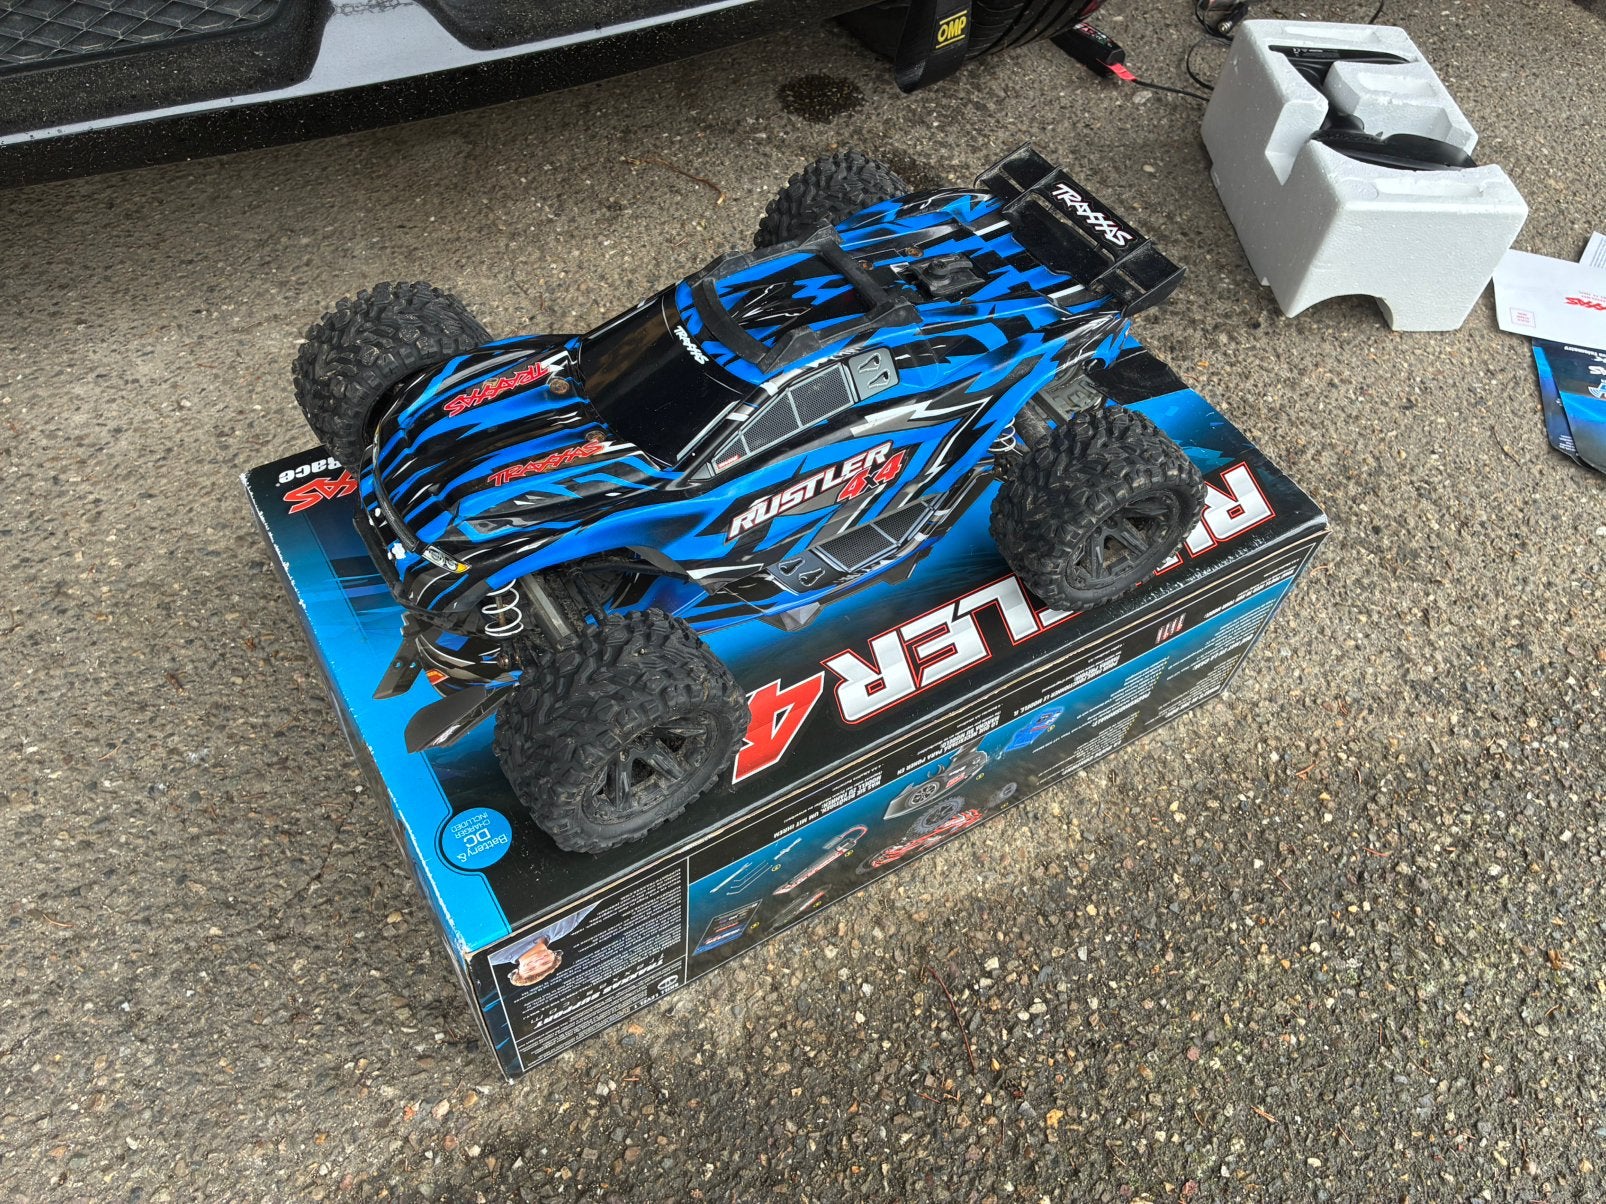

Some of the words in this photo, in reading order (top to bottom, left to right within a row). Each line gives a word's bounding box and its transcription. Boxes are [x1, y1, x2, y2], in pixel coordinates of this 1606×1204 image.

[937, 15, 967, 43] OMP
[1052, 184, 1134, 246] TRAXXAS
[674, 326, 710, 364] TRAXXAS
[443, 362, 550, 418] TRAXXAS
[488, 438, 604, 487] TRAXXAS
[726, 440, 894, 542] RUSTLER
[451, 812, 488, 833] INCLUDED
[454, 820, 491, 839] CHARGER
[463, 828, 492, 848] DC
[456, 853, 468, 862] &
[467, 834, 508, 857] Battery
[602, 958, 663, 994] TRAXXAS
[532, 990, 601, 1030] SUPPORT
